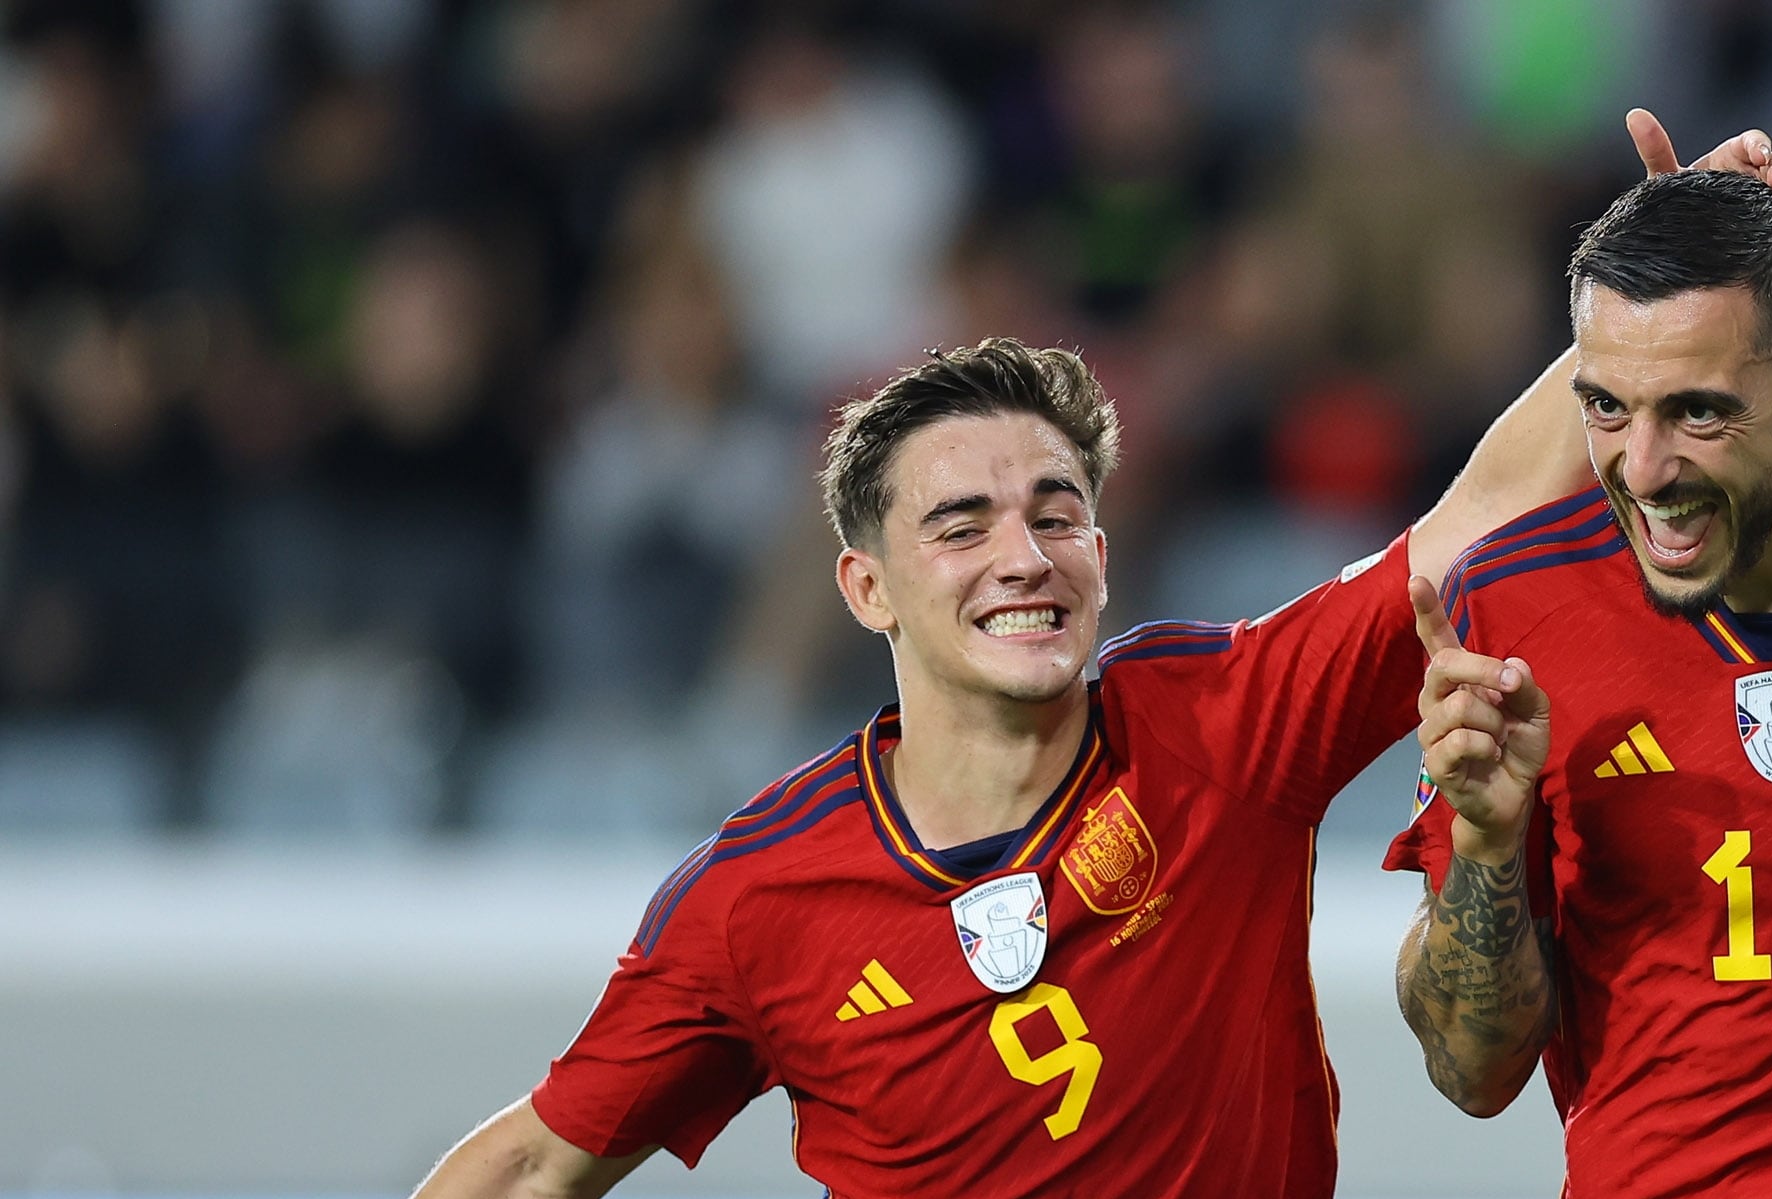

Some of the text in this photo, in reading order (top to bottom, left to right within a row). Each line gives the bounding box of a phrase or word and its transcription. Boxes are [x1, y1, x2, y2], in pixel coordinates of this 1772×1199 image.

[1740, 679, 1760, 690] UEFA
[974, 882, 1005, 898] NATIONS
[988, 982, 1103, 1141] 9
